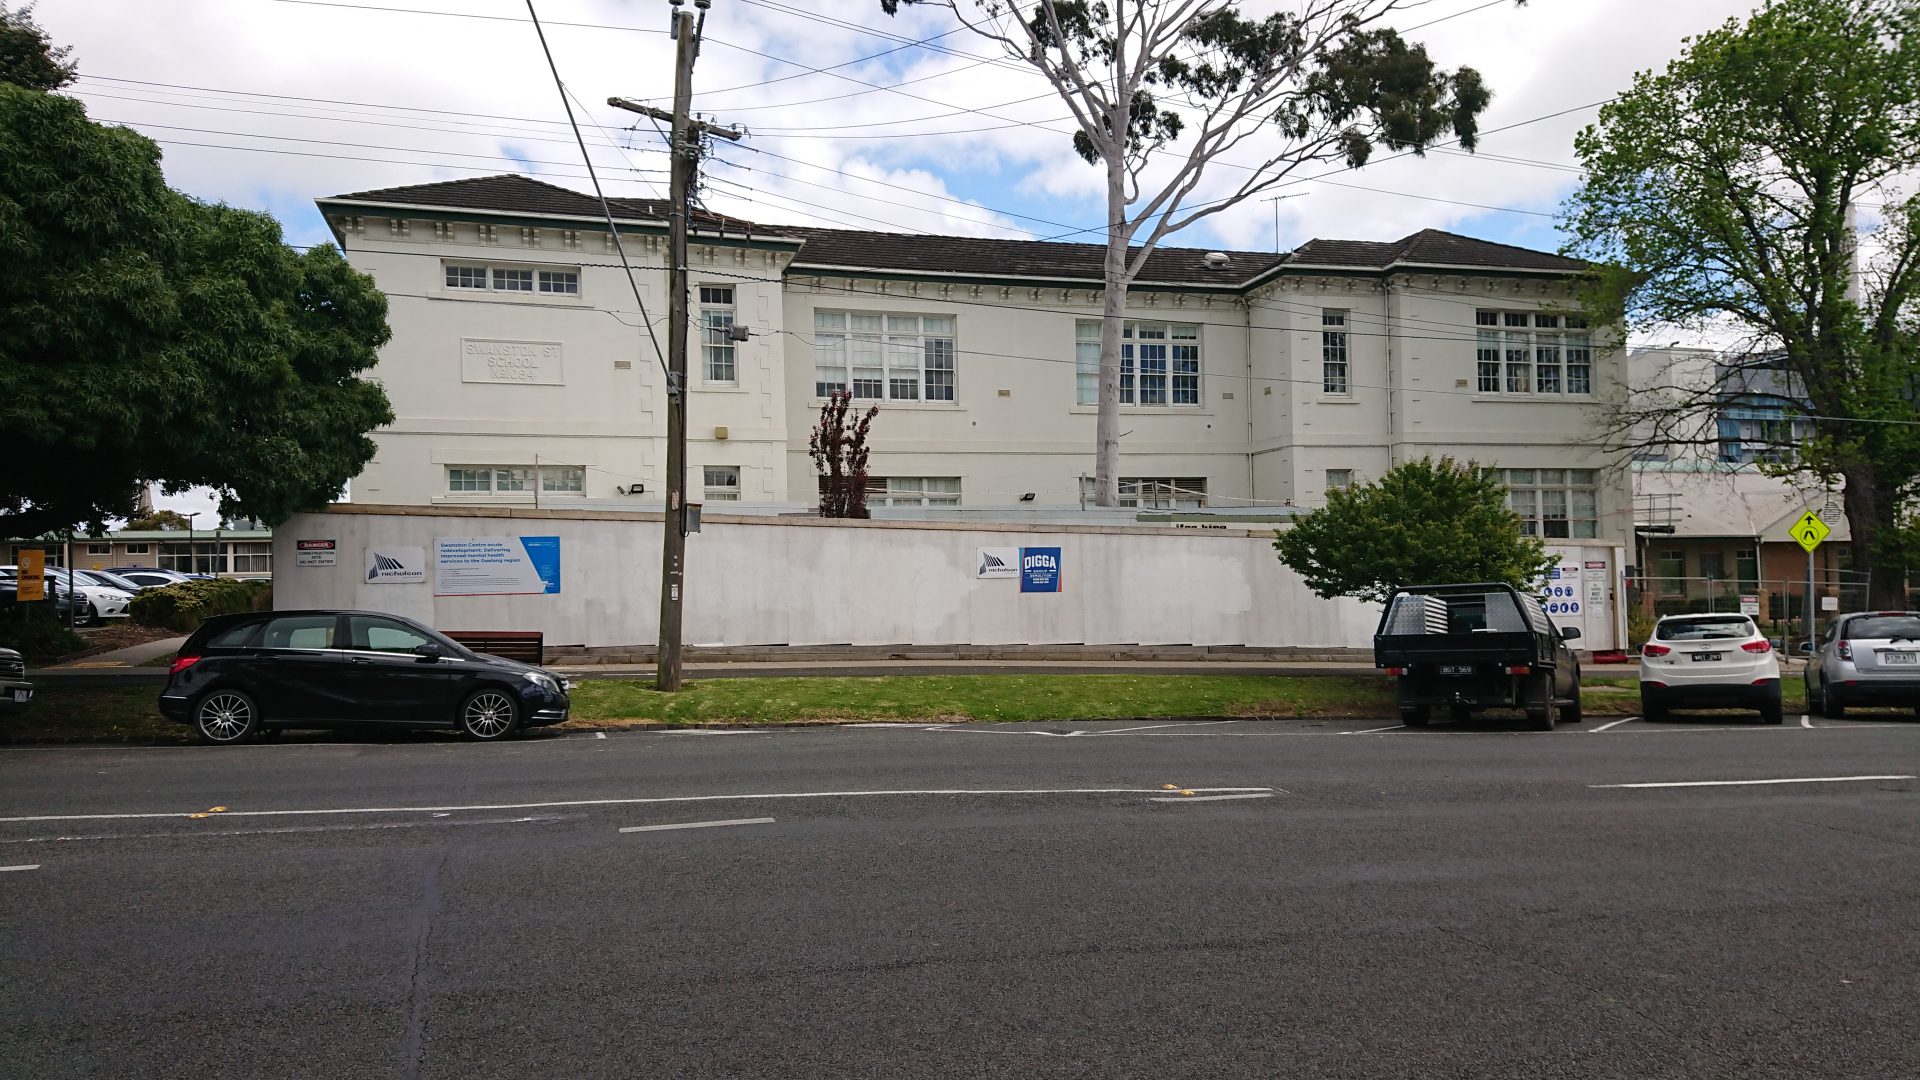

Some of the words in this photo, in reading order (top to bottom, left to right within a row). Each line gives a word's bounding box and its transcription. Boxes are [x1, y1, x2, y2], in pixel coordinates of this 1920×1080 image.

[465, 343, 538, 357] SWANSTON
[543, 345, 560, 357] ST
[487, 357, 540, 369] SCHOOL
[1024, 555, 1056, 569] DIGGA
